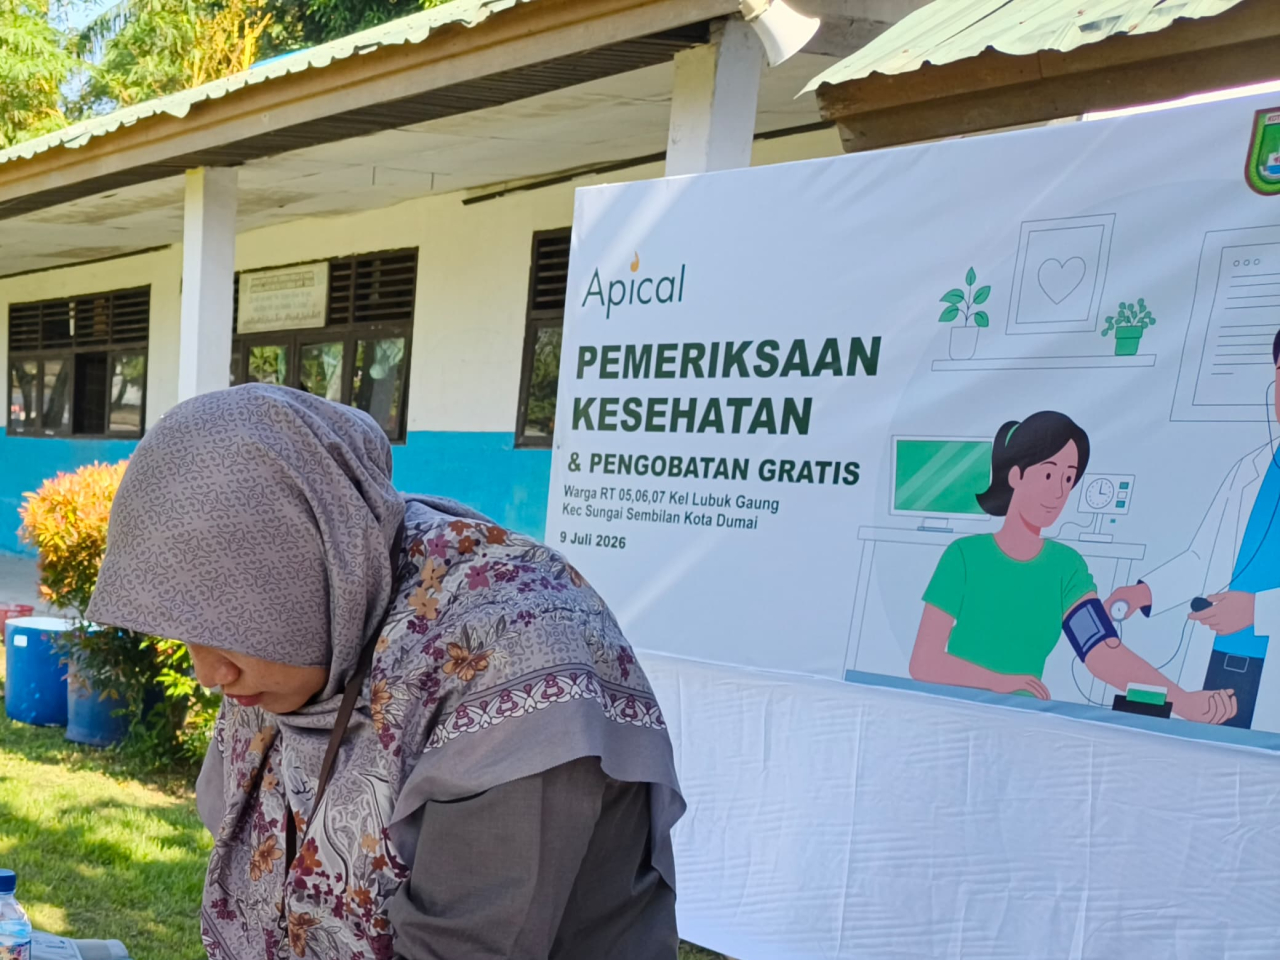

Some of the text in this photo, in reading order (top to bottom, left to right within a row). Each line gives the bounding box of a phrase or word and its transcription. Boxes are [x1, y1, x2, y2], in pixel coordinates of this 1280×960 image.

[581, 252, 686, 320] Apical
[576, 336, 882, 379] PEMERIKSAAN
[571, 397, 813, 435] KESEHATAN
[567, 452, 860, 486] & PENGOBATAN GRATIS
[562, 503, 758, 530] Kec Sungai Sembilan Kota Dumai
[564, 485, 780, 514] Warga RT 05,06,07 Kel Lubuk Gaung
[559, 531, 626, 549] 9 Juli 2026
